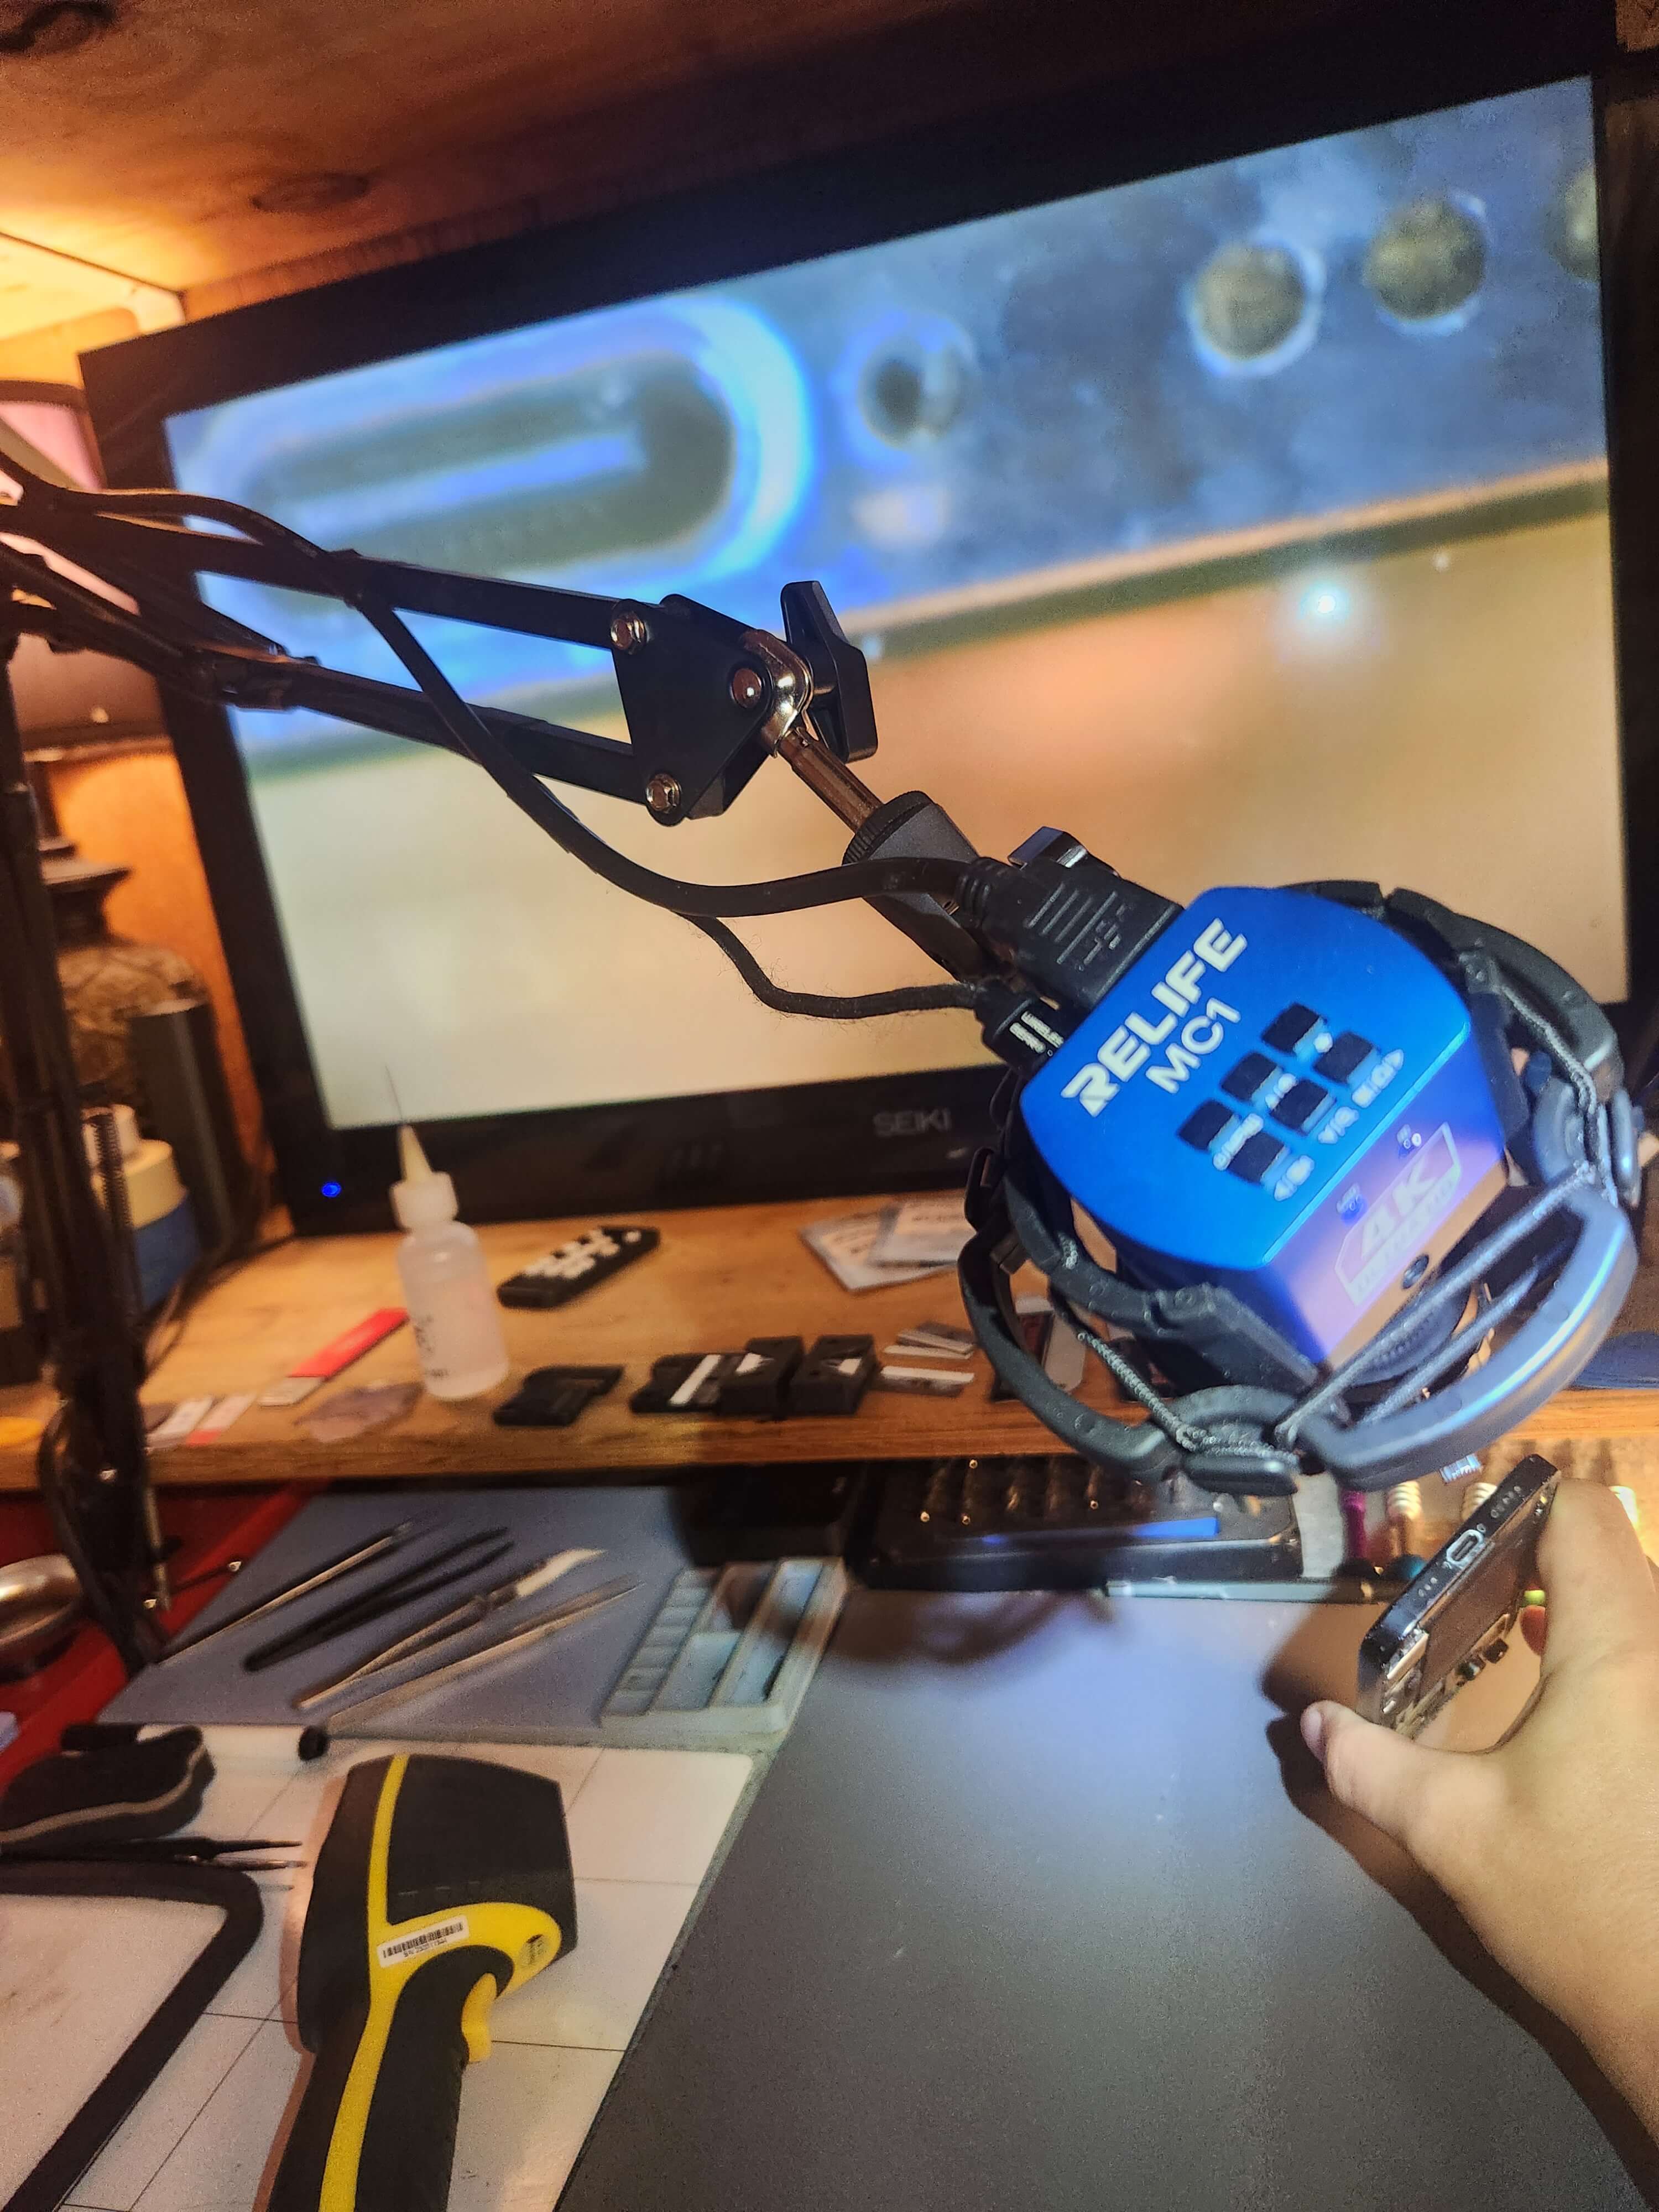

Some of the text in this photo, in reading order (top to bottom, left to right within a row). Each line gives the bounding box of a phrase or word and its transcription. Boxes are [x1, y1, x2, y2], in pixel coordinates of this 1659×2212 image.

[1061, 917, 1248, 1118] RELIFE
[1146, 997, 1241, 1094] MC1
[873, 1108, 951, 1136] SEIKI
[1361, 1154, 1438, 1260] 4K
